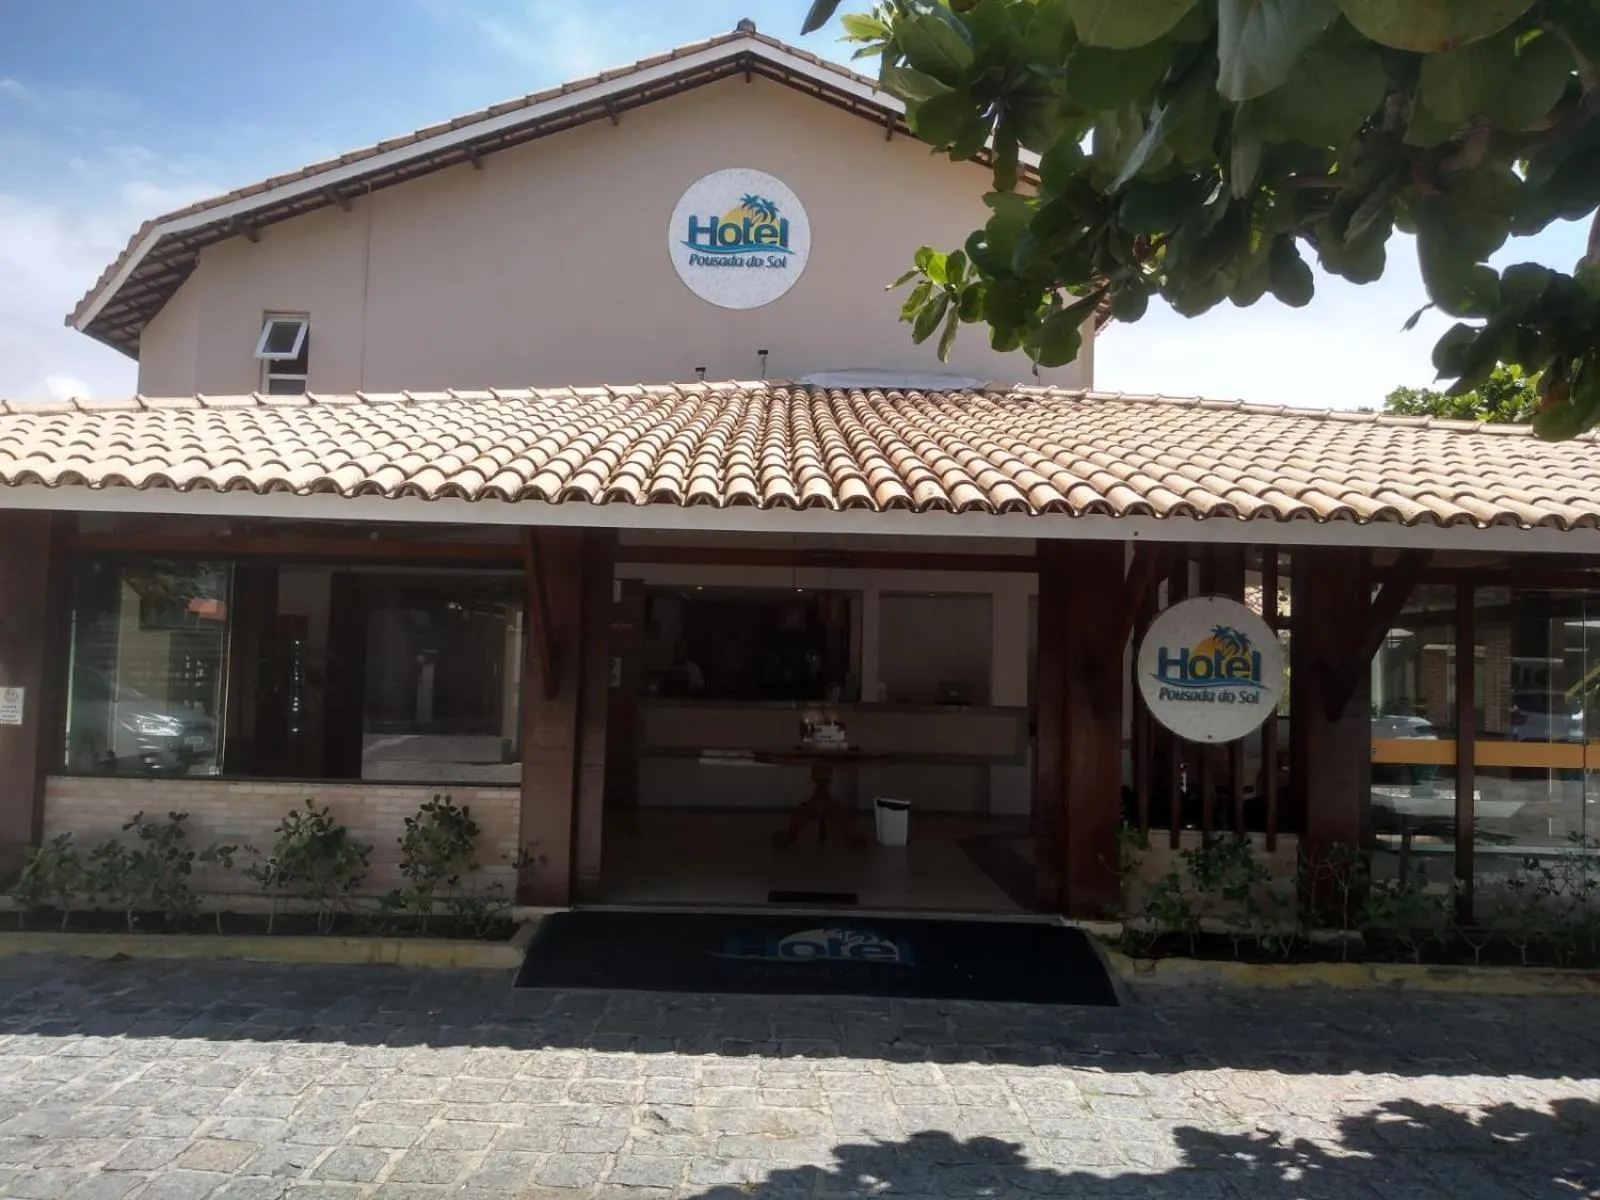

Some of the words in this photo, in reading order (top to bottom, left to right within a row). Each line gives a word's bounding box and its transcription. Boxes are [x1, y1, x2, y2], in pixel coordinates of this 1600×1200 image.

[688, 215, 789, 247] Hotel
[689, 254, 744, 268] Pousada
[746, 255, 764, 269] do
[766, 255, 788, 269] Sol
[1158, 646, 1262, 682] Hotel
[1159, 687, 1215, 702] Pousada
[1218, 689, 1237, 703] do
[1238, 690, 1260, 704] Sol
[724, 935, 915, 962] Hotel
